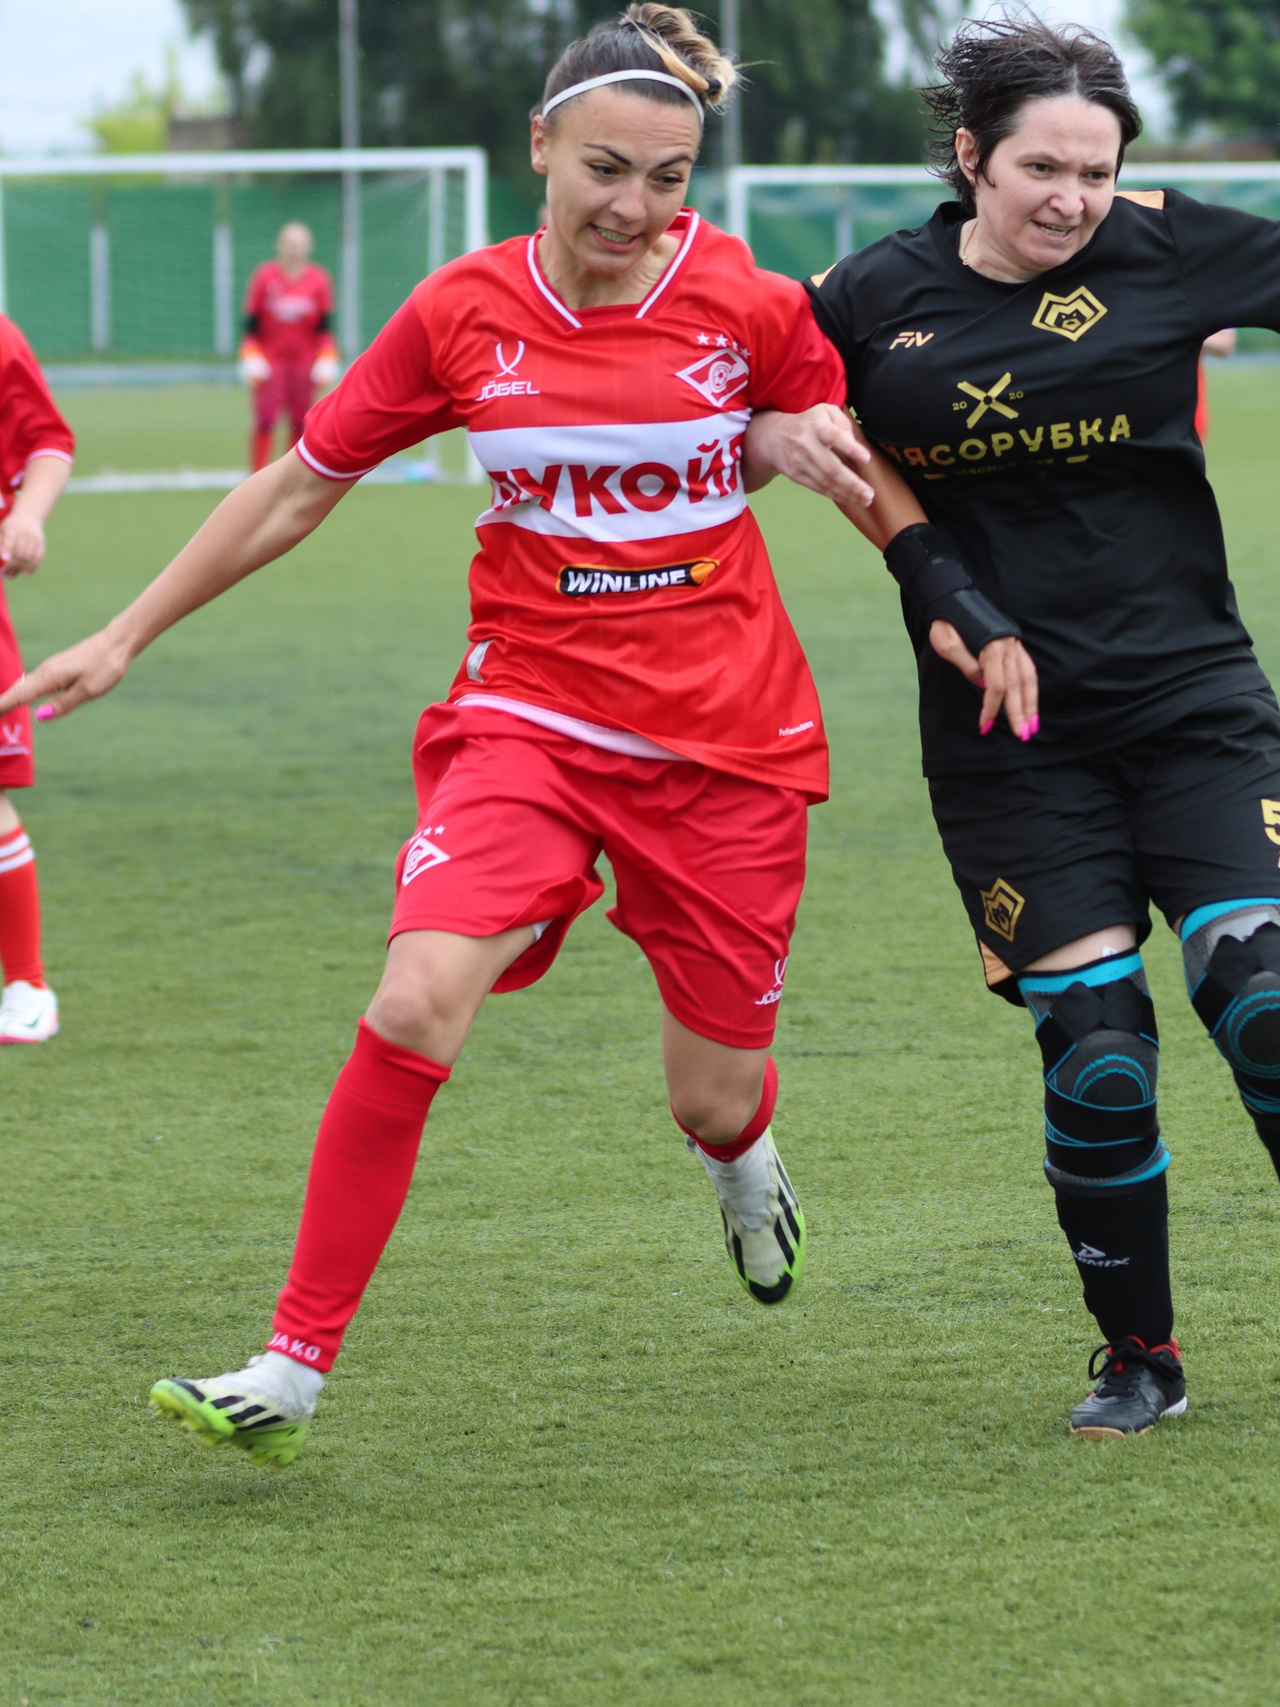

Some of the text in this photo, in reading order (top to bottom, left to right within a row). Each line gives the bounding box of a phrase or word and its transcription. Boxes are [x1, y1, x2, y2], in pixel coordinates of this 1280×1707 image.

[475, 380, 540, 401] JÖGEL
[951, 390, 1025, 412] 20 20
[268, 1331, 322, 1362] JAKO
